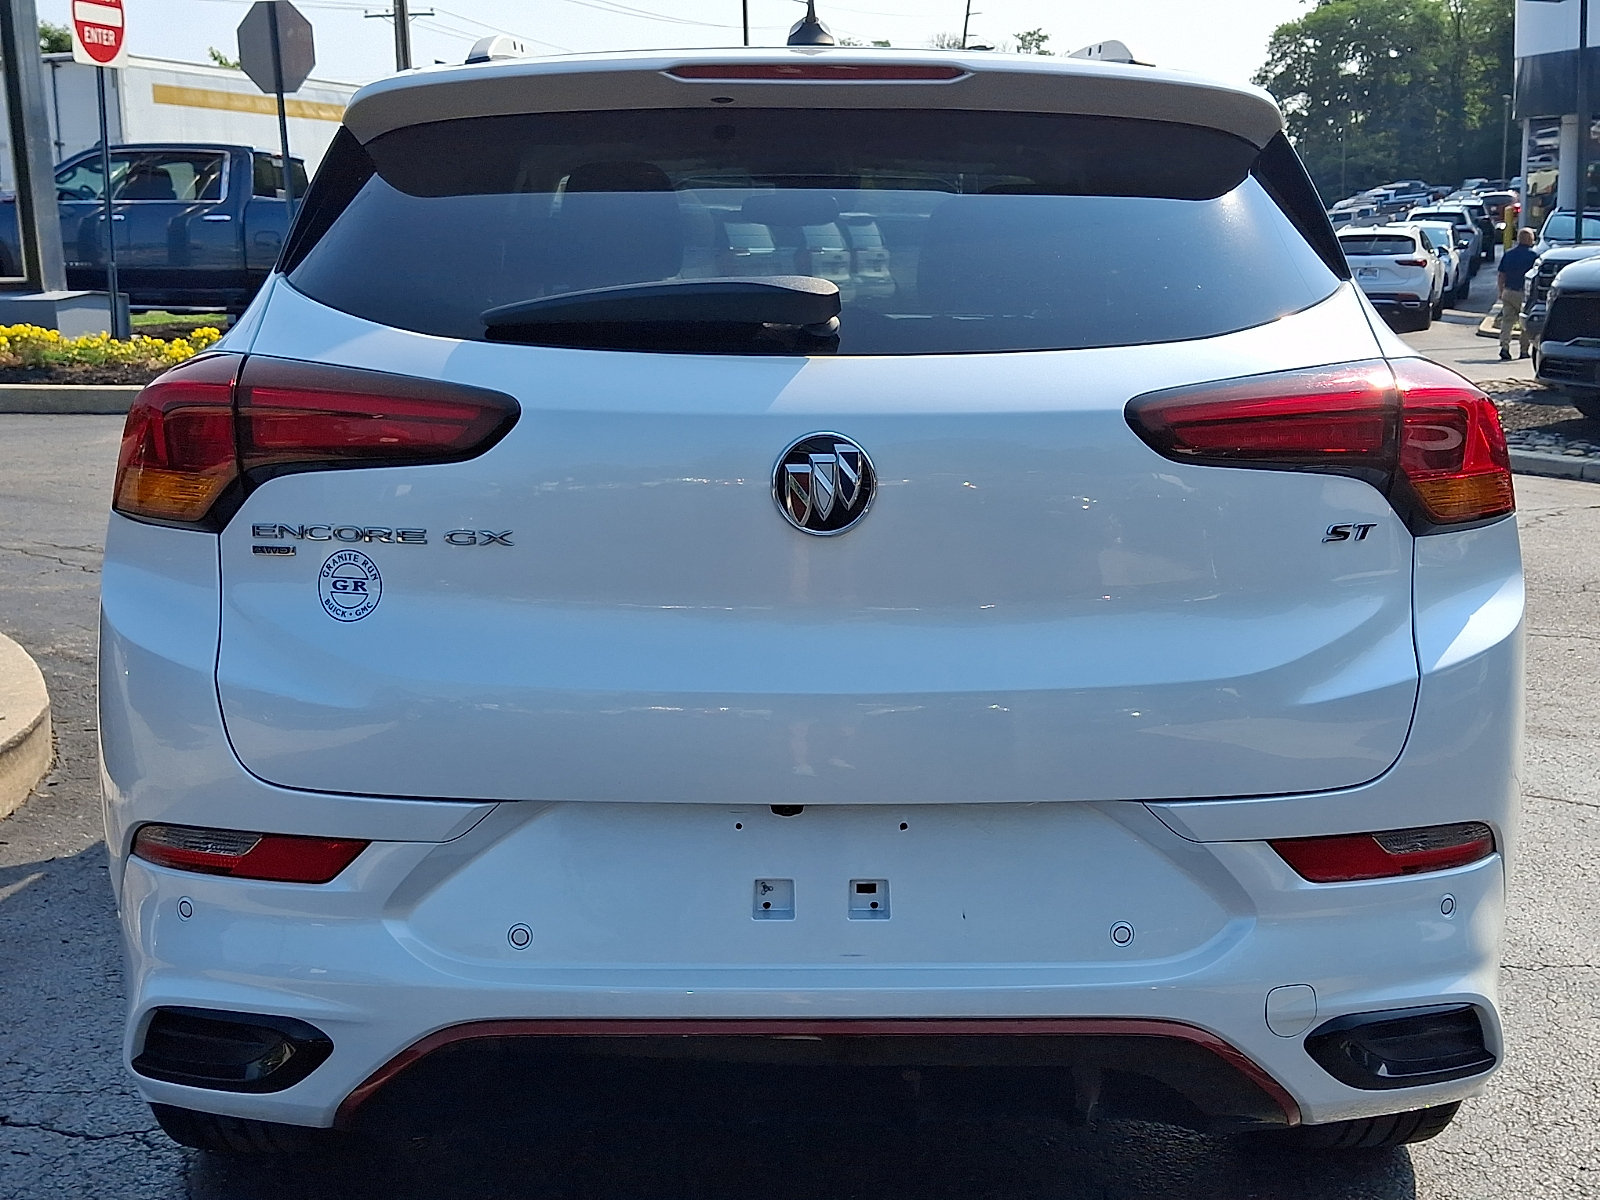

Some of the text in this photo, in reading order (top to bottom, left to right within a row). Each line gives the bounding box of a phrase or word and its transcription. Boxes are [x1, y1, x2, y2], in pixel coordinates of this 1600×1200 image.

[84, 26, 115, 46] ENTER
[252, 523, 514, 546] ENCORE GX
[1322, 523, 1377, 543] ST
[324, 554, 378, 581] GRANITE RUN
[325, 599, 373, 617] BUICK GMC
